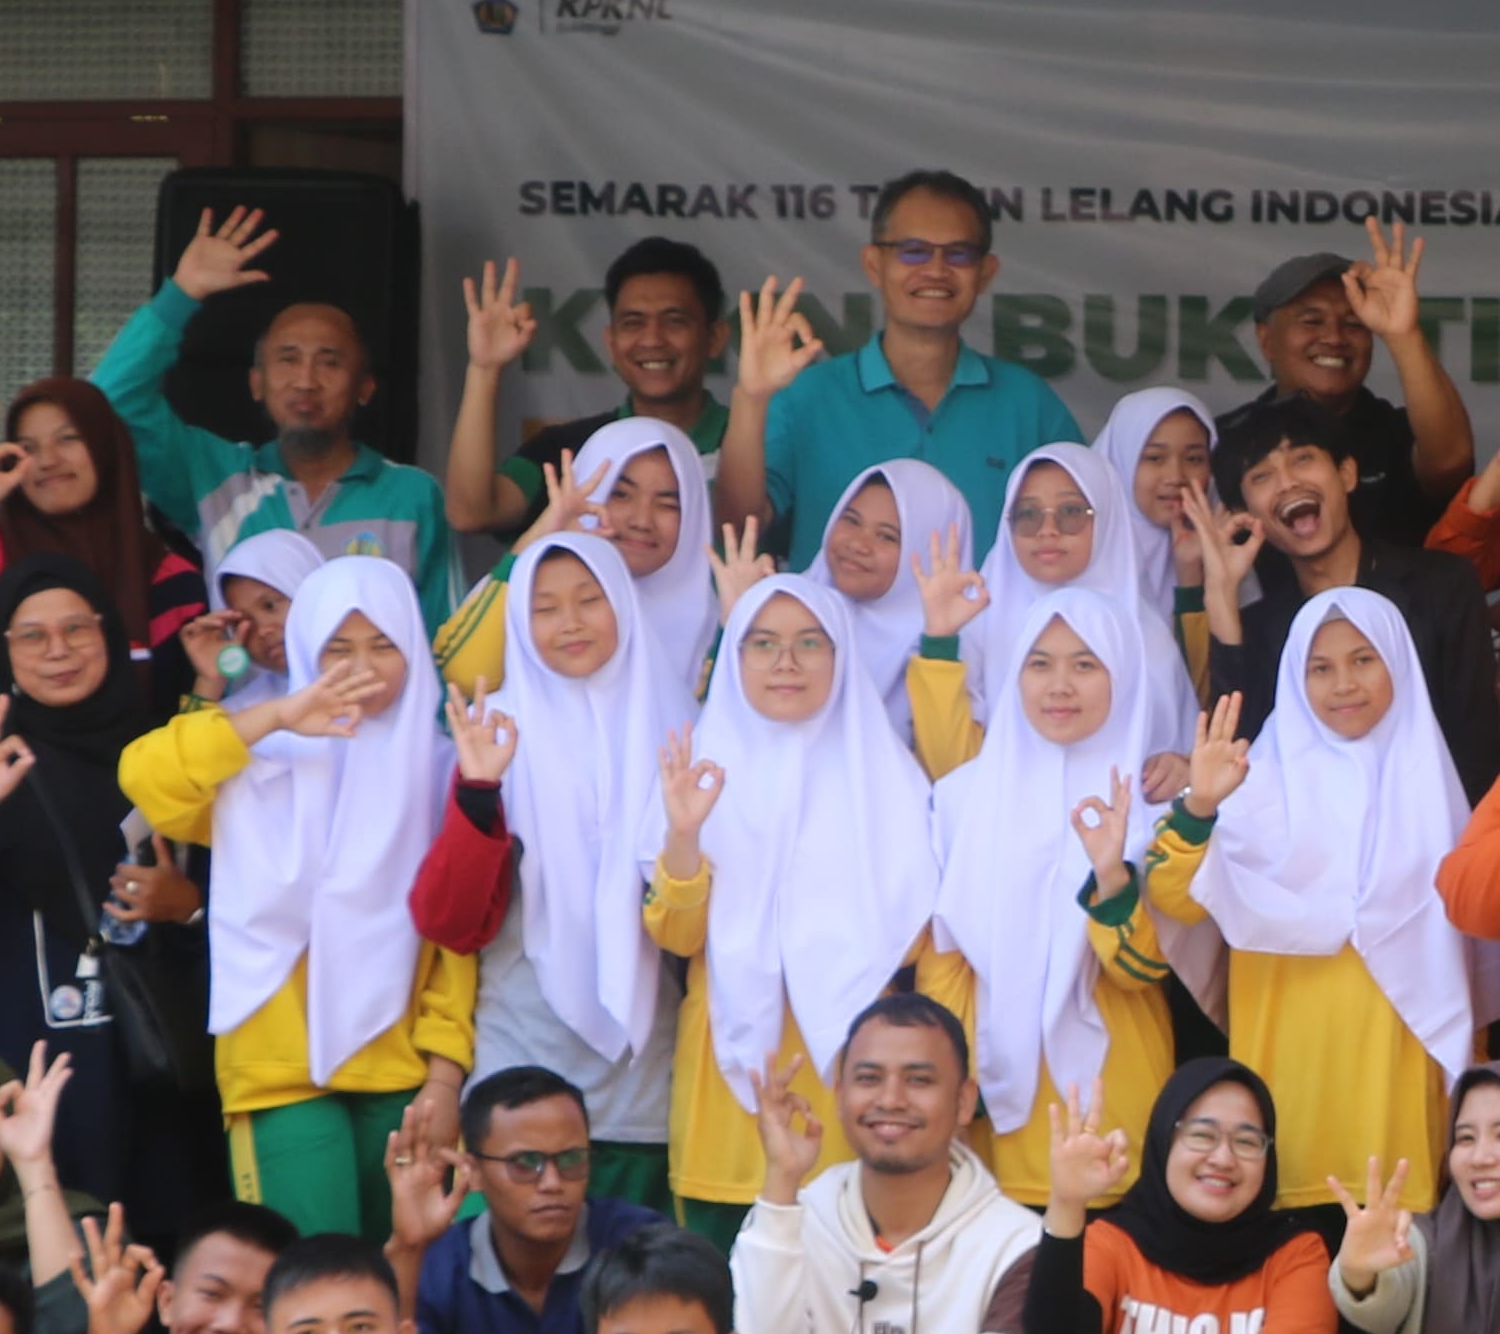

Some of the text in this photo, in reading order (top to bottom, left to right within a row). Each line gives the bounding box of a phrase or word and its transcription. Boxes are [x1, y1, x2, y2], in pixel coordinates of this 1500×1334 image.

[518, 180, 758, 221] SEMARAK
[771, 184, 837, 221] 116
[1041, 187, 1235, 224] LELANG
